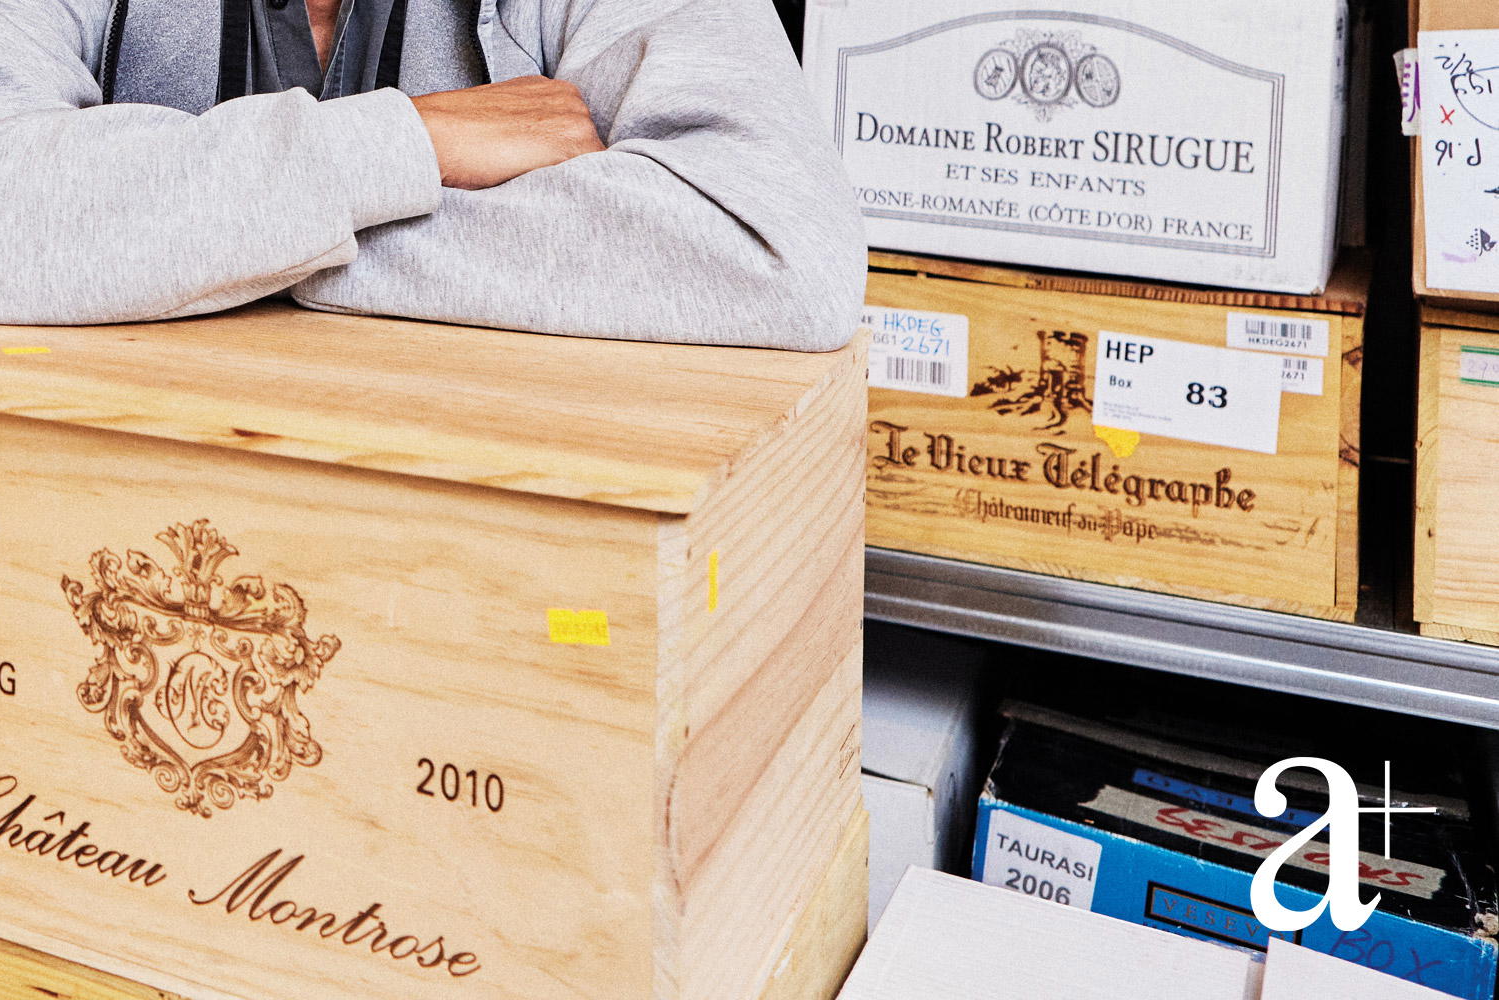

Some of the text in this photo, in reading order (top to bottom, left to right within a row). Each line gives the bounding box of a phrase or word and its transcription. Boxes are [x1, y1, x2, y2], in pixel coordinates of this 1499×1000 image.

[1092, 128, 1258, 177] SIRUGUE
[944, 163, 1147, 200] ET SES ENFANTS
[1027, 201, 1254, 245] (CÔTE D'OR) FRANCE
[884, 312, 946, 338] HKDEG
[900, 335, 950, 357] 2671
[1104, 338, 1155, 365] HEP
[1108, 374, 1229, 410] Box 83
[869, 419, 1257, 521] Le Vieux Télégraphe
[416, 758, 506, 815] 2010
[996, 831, 1096, 882] TAURASI
[1005, 867, 1072, 908] 2006
[187, 846, 481, 979] Montrose
